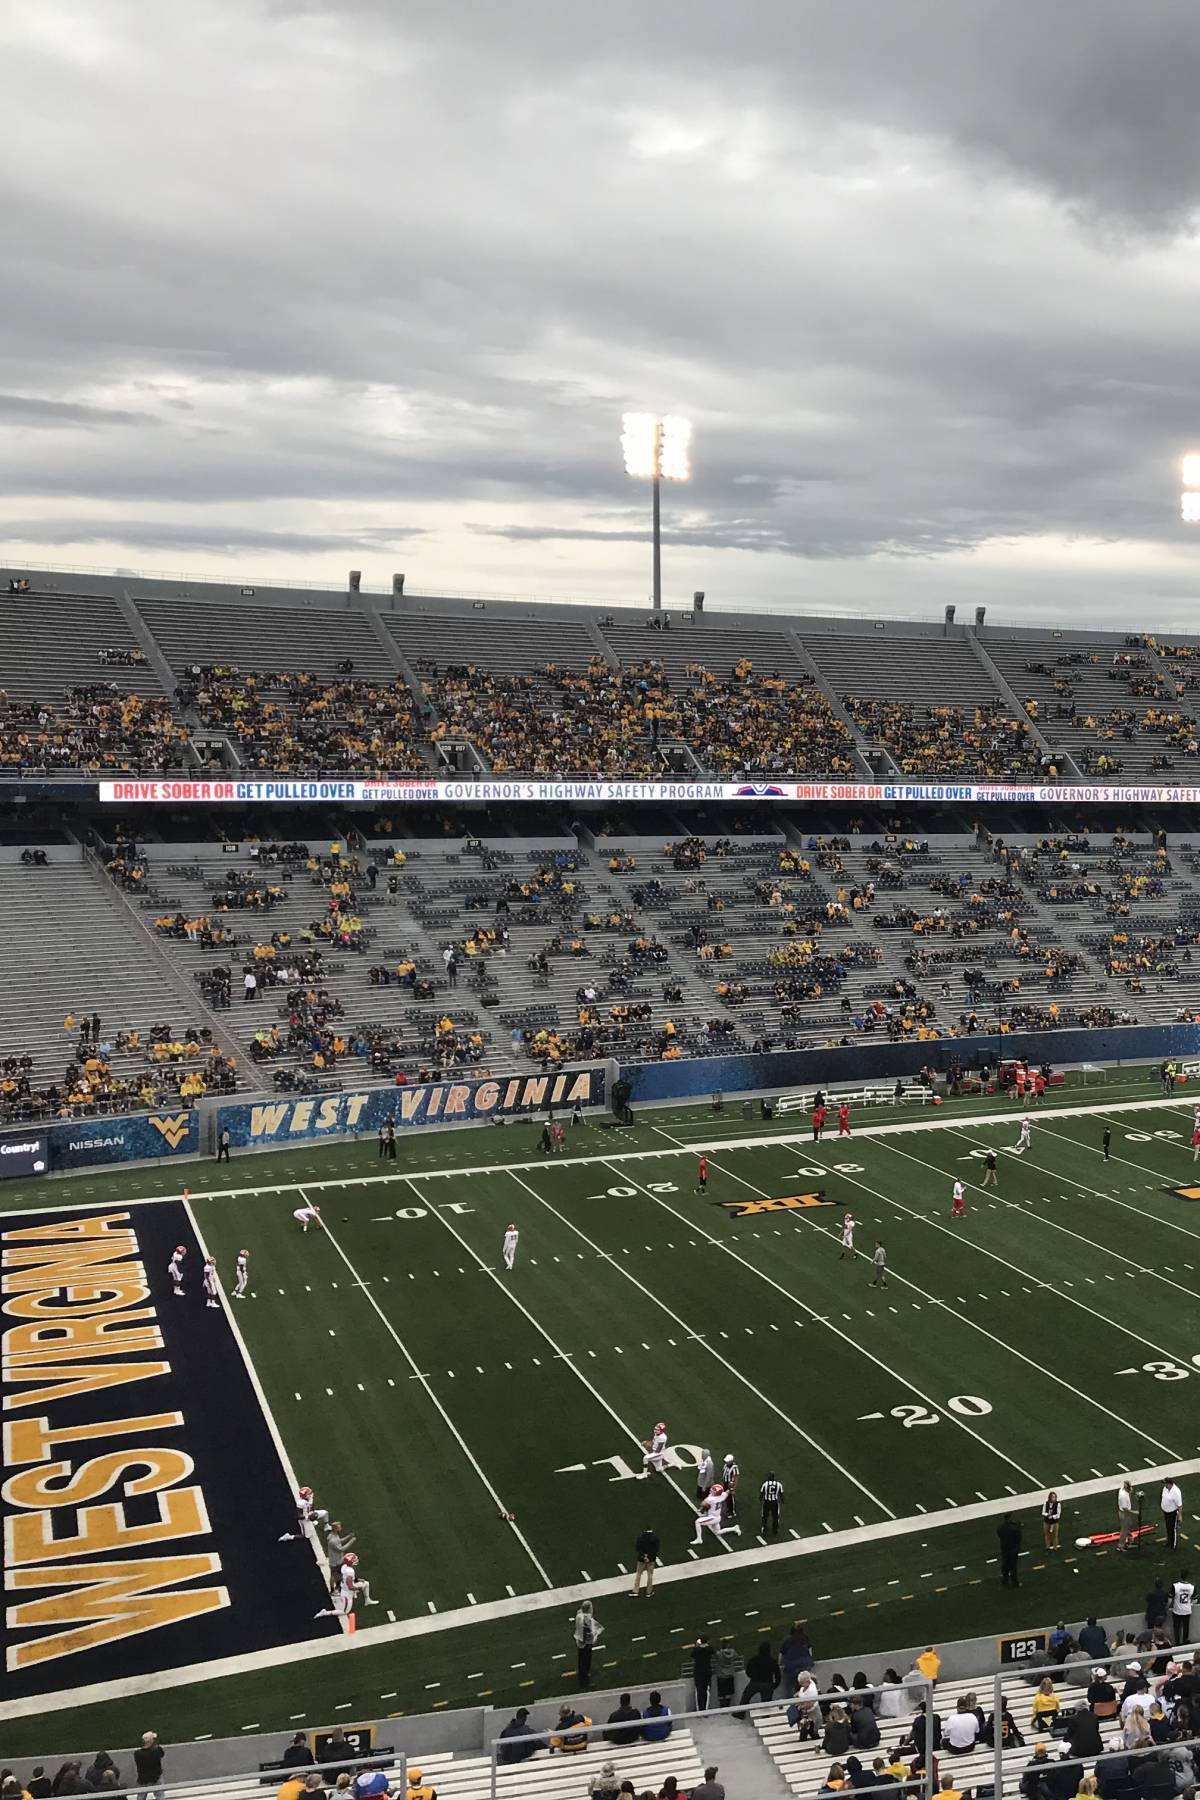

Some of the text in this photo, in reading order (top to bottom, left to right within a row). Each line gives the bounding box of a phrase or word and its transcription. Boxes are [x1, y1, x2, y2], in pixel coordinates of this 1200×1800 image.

[113, 783, 355, 799] DRIVE SOBER OR GET PULLED OVER
[362, 789, 438, 799] GET PULLED OVER
[444, 784, 723, 798] GOVERNOR'S HIGHWAY SAFETY PROGRAM
[796, 785, 972, 799] DRIVE SOBER OR GET PULLED OVER
[976, 791, 1035, 801] GET PULLED OVER
[1039, 788, 1109, 801] GOVERNOR'S
[1113, 788, 1163, 801] HIGHWAY
[250, 1073, 591, 1136] WEST VIRGINIA
[69, 1135, 125, 1151] NISSAN
[1124, 1129, 1184, 1142] 50
[0, 1140, 40, 1155] Country!
[797, 1162, 866, 1177] 30
[606, 1181, 680, 1197] 20
[395, 1202, 477, 1218] 10
[890, 1395, 994, 1428] 20
[2, 1212, 232, 1672] WEST VIRGINIA
[1010, 1639, 1037, 1659] 123
